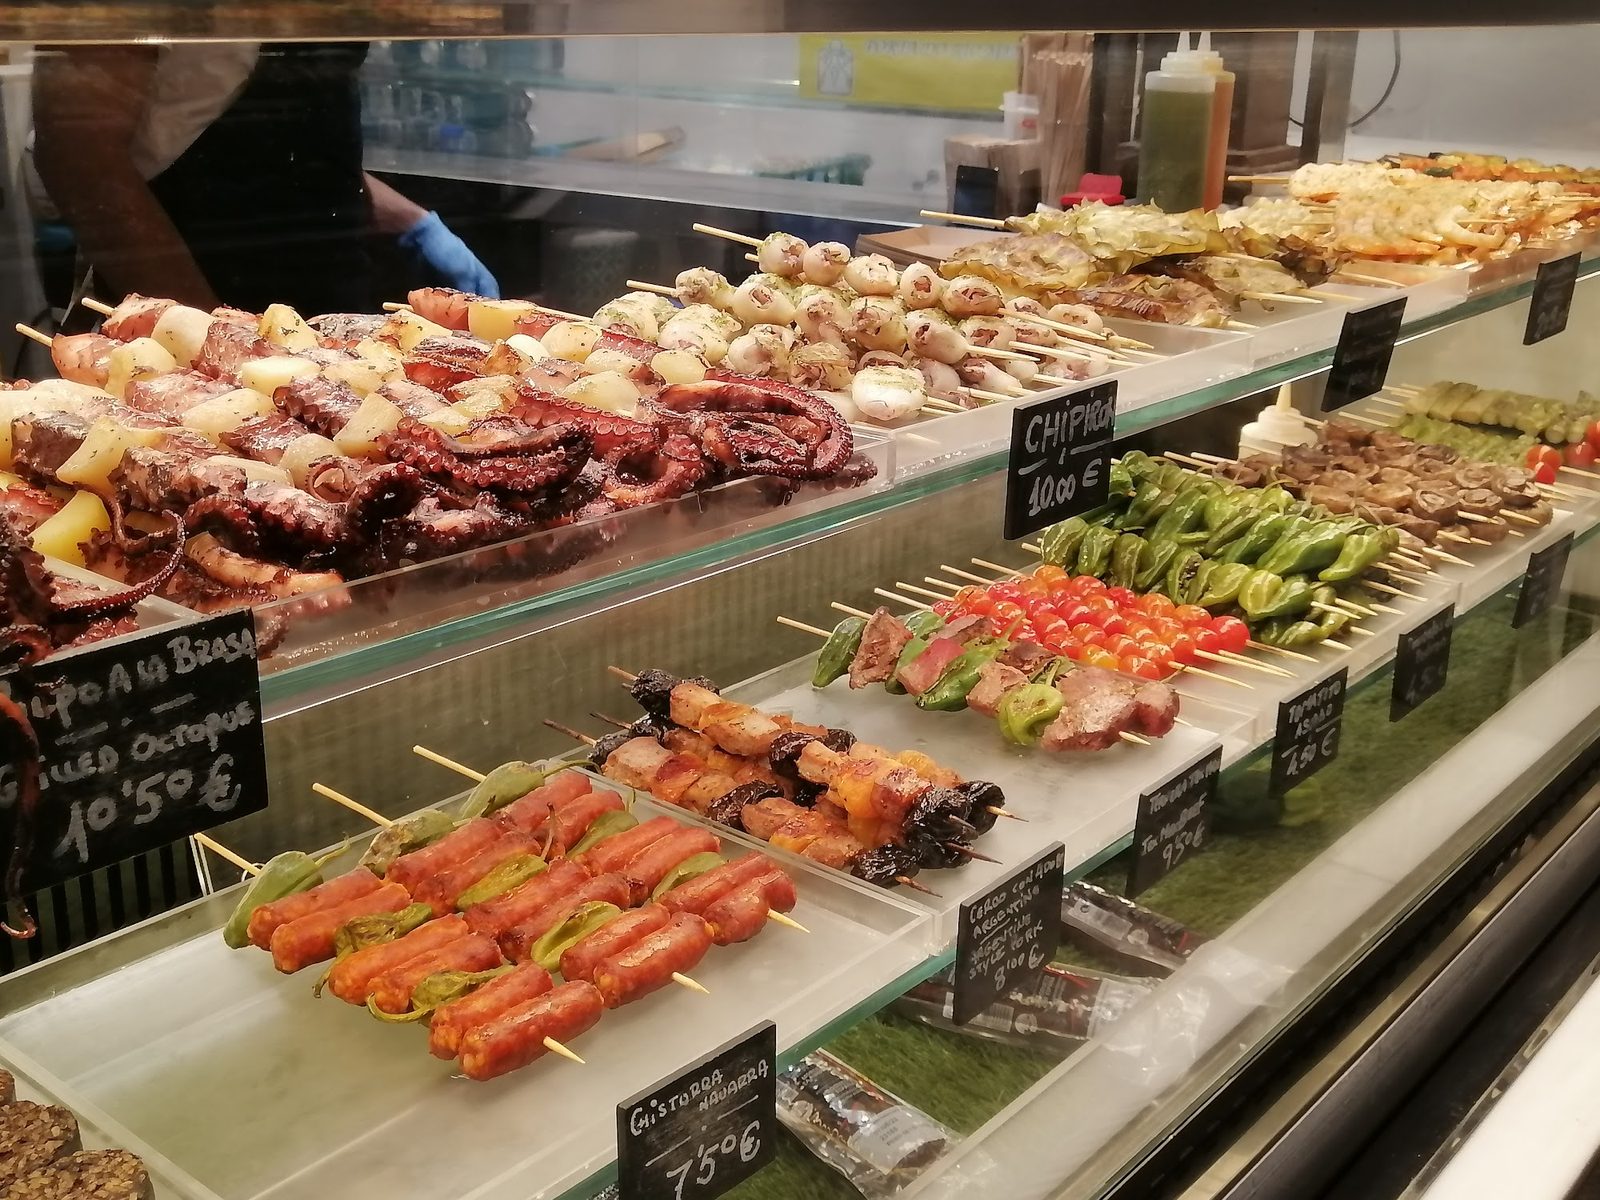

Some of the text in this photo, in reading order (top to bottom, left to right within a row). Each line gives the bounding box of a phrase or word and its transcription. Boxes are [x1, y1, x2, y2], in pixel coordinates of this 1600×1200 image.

[1028, 458, 1102, 517] 10.00 €
[109, 664, 132, 695] A
